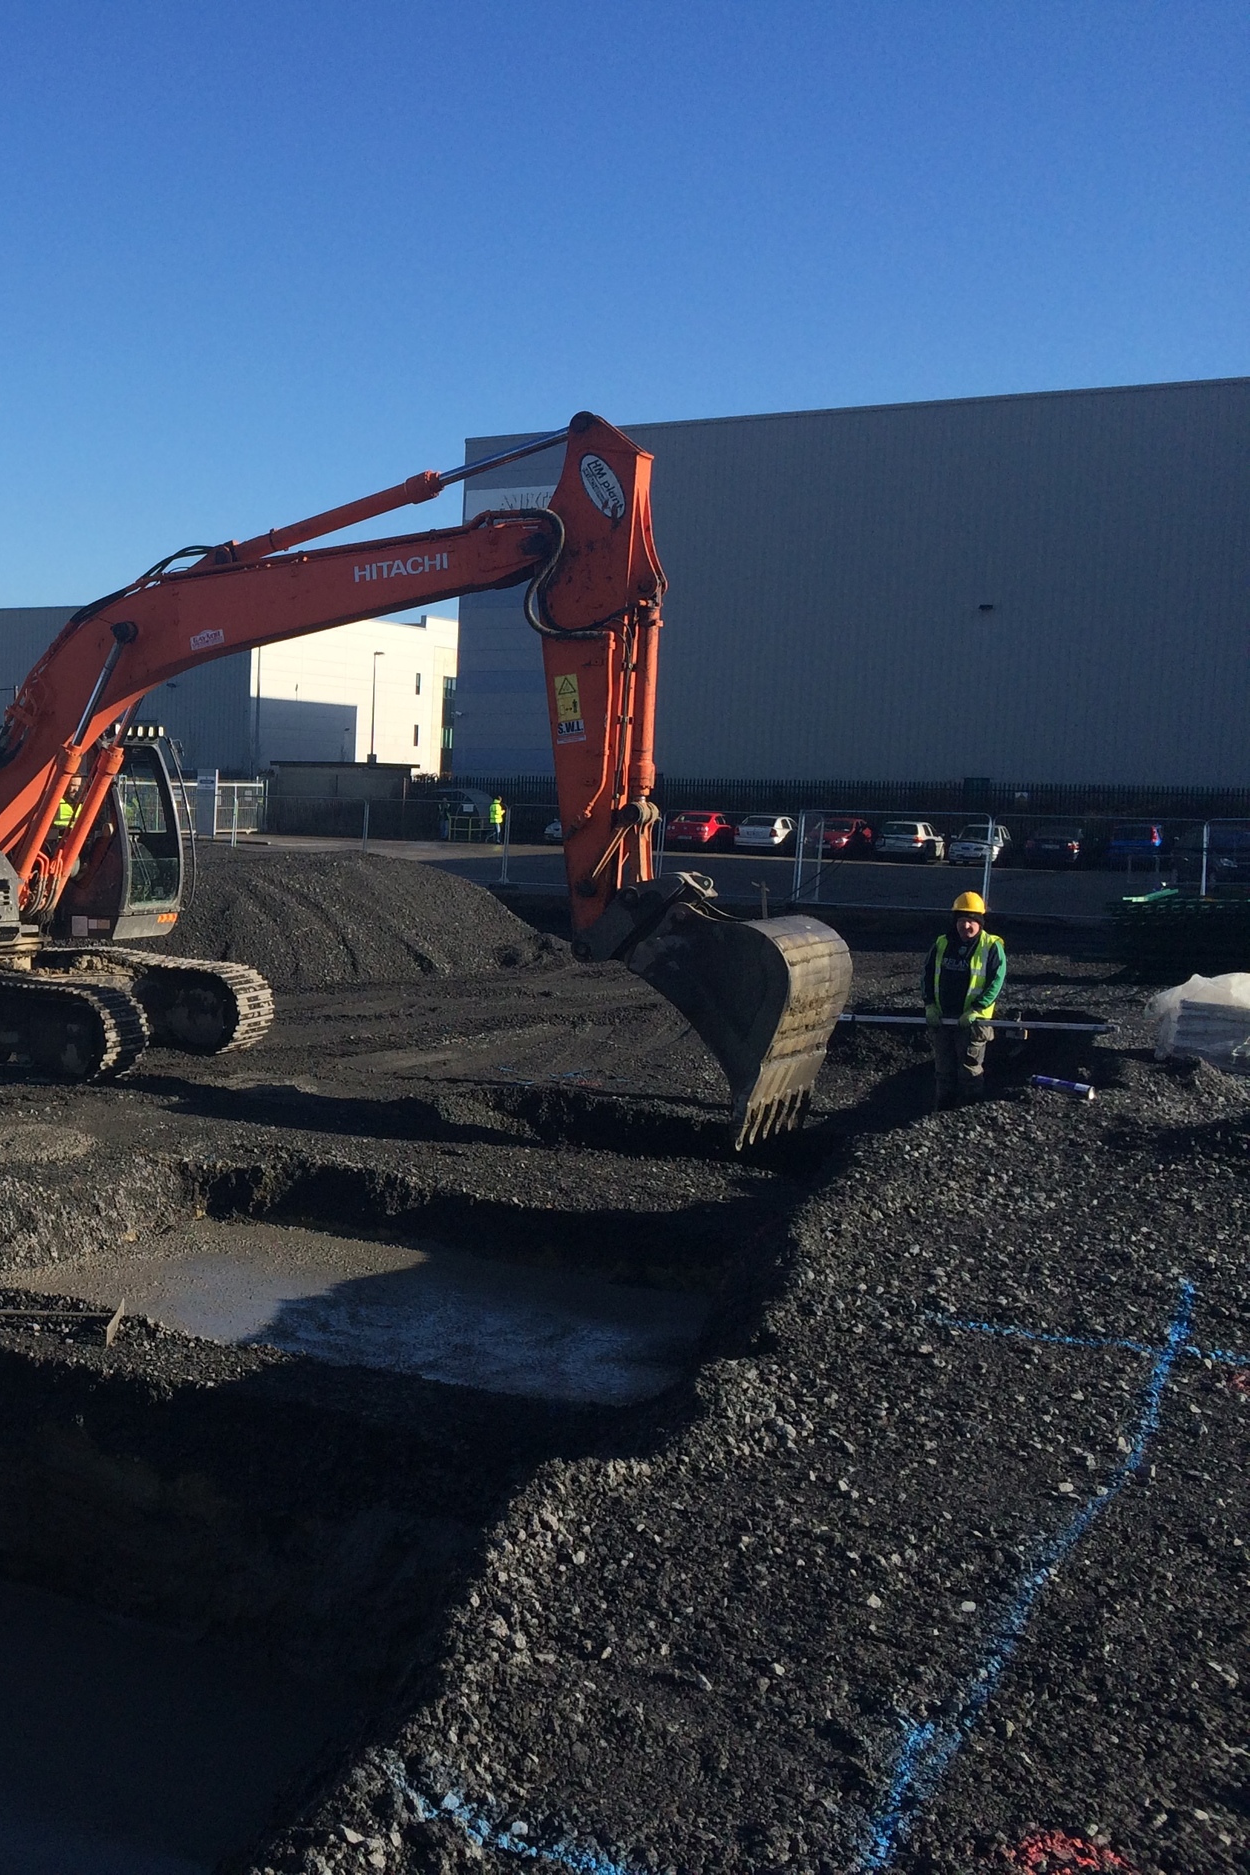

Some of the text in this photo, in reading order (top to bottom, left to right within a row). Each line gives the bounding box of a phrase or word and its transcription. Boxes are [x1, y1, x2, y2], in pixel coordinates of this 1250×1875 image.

[588, 459, 607, 479] HM
[601, 480, 624, 510] plant
[353, 552, 448, 583] HITACHI
